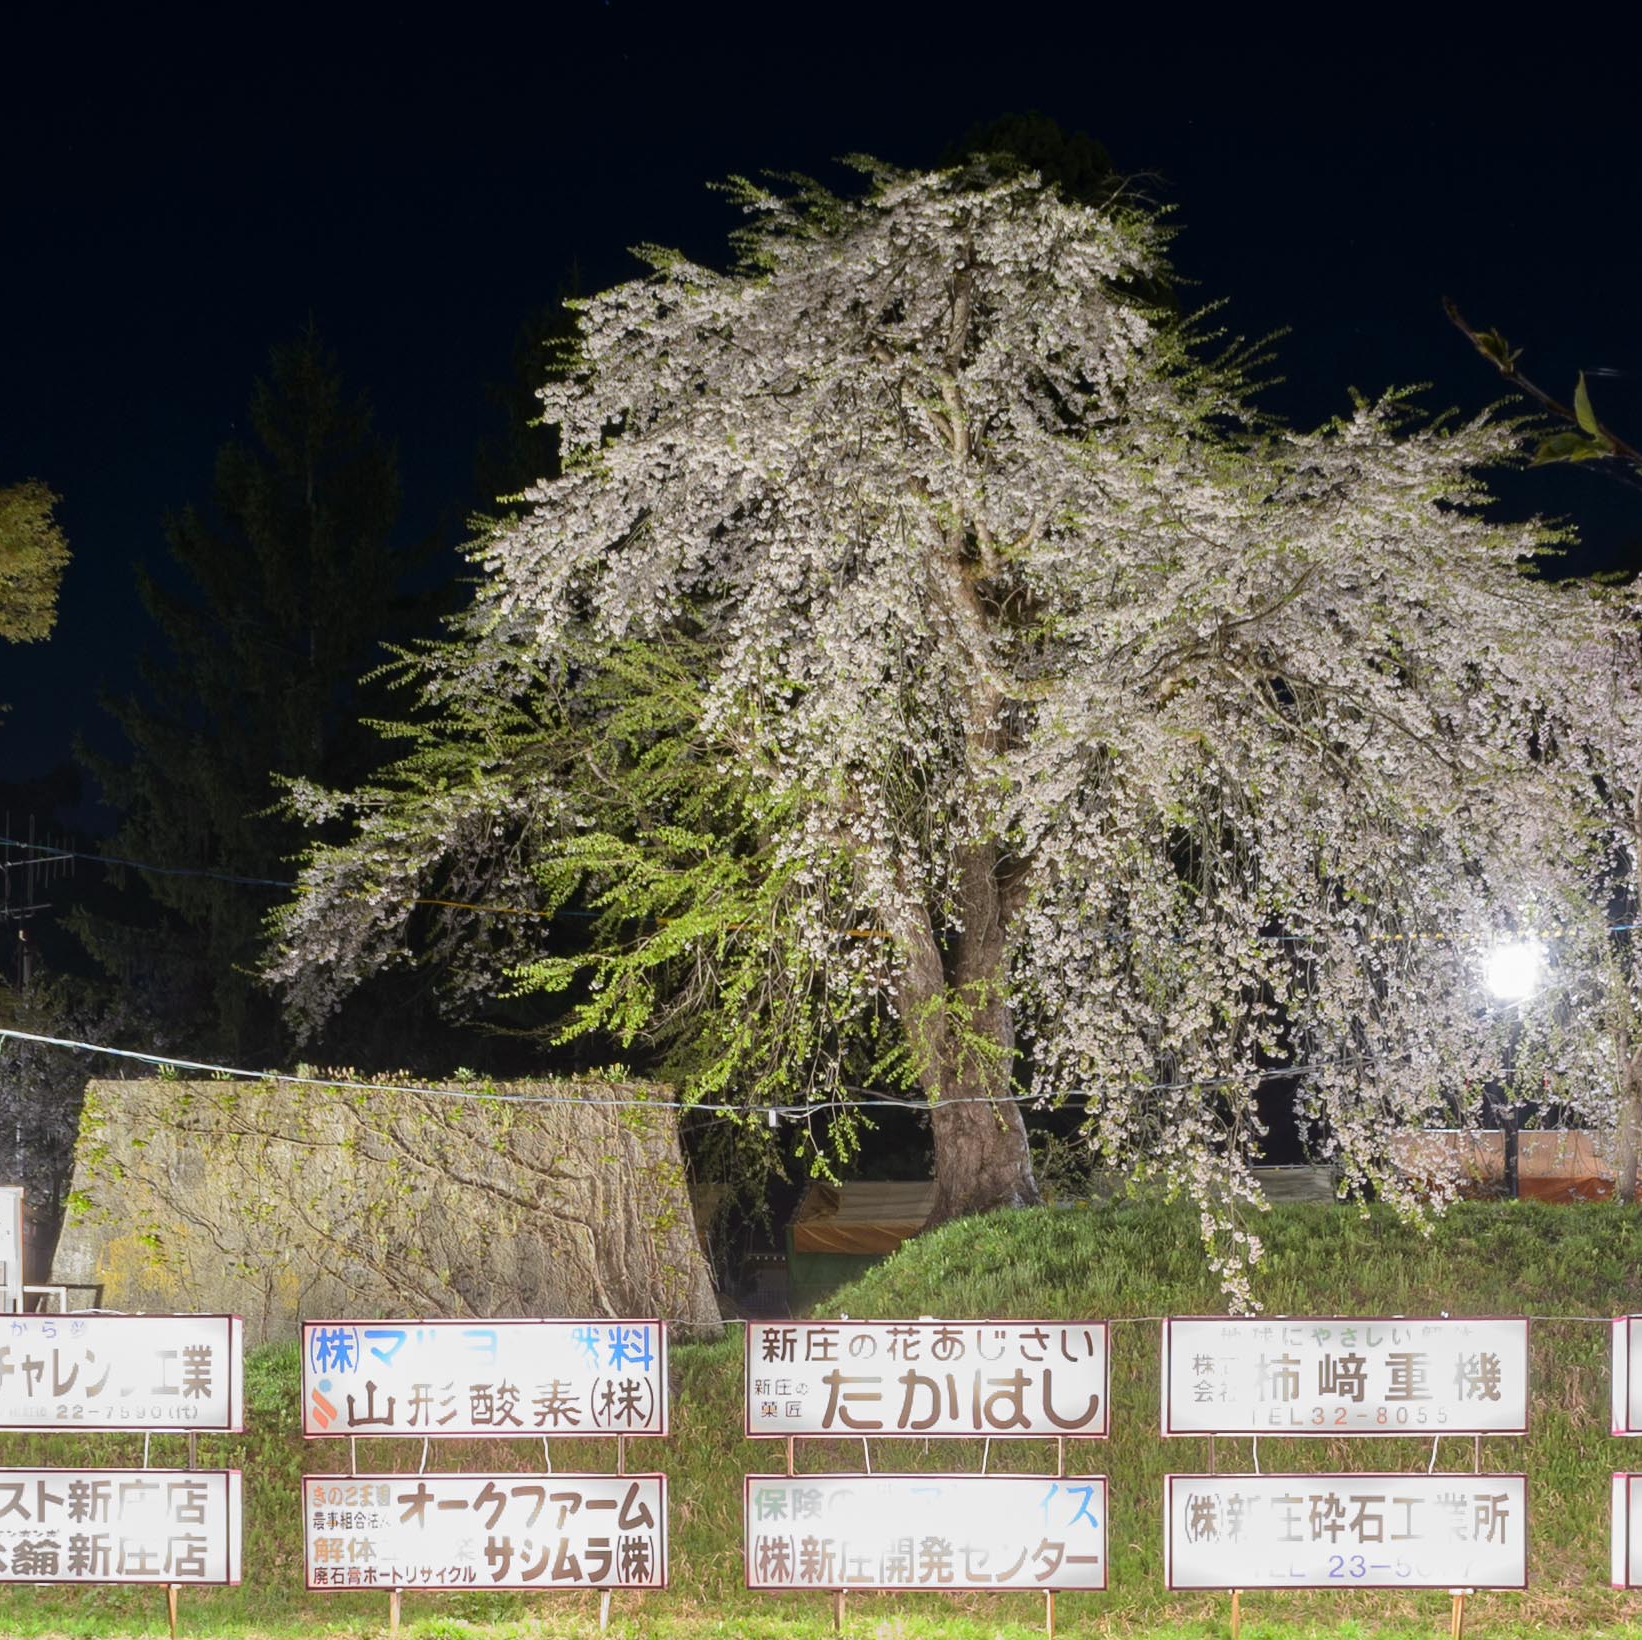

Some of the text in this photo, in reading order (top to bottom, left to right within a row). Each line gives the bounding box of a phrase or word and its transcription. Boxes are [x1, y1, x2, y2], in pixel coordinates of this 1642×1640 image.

[761, 1327, 1095, 1364] 新庄の花あじさい
[345, 1378, 655, 1429] 山形酸素(株)
[820, 1367, 1101, 1430] たかはし
[396, 1481, 655, 1532] オークファーム
[483, 1535, 655, 1584] サシムラ(株)
[754, 1534, 1099, 1585] (株)新庄開発センター
